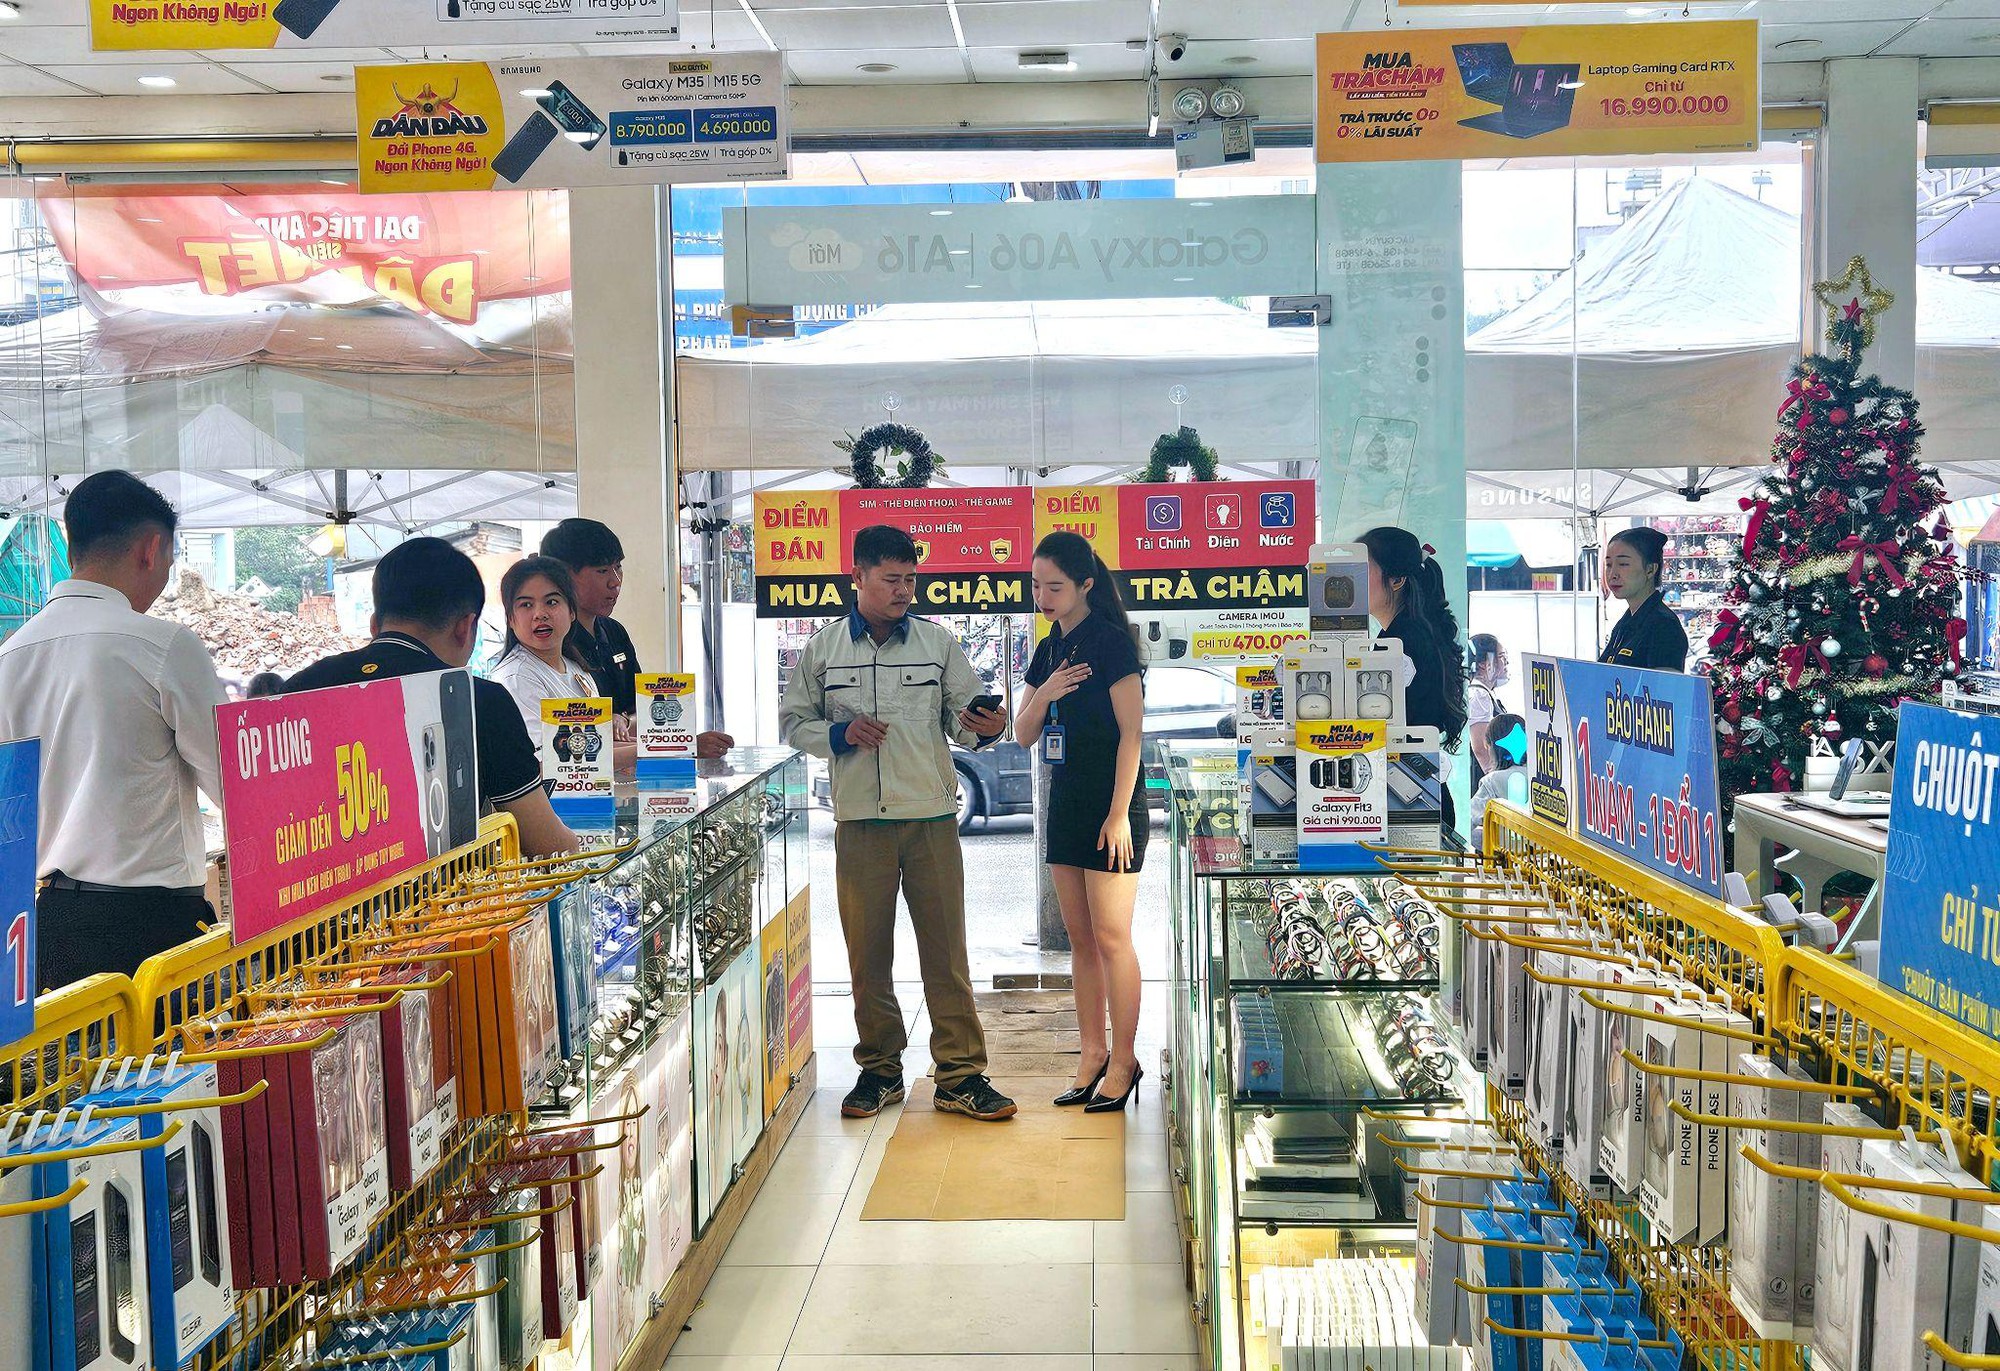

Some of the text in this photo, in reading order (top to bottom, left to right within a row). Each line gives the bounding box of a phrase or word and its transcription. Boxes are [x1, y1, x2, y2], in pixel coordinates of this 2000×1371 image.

[112, 4, 158, 24] Ngon
[162, 2, 220, 23] Không
[1362, 52, 1412, 69] MUA
[1588, 61, 1735, 76] Laptop Gaming Card RTX
[622, 73, 762, 92] Galaxy M35 M15 5G
[1600, 95, 1730, 117] 16.990.000
[616, 122, 686, 138] 8.790.000
[700, 119, 771, 134] 4.690.000
[1336, 123, 1423, 139] 0% LÃI SUẤT
[412, 142, 452, 155] Phone
[629, 151, 654, 162] Tặng
[669, 151, 688, 161] sạc
[689, 149, 710, 157] 25W
[738, 147, 757, 160] góp
[759, 147, 772, 155] 0%
[375, 159, 408, 174] Ngon
[411, 157, 452, 174] Không
[859, 499, 877, 510] SIM
[903, 497, 928, 511] ĐIỆN
[928, 498, 958, 511] THOẠI
[985, 498, 1013, 507] GAME
[1047, 489, 1101, 514] ĐIỂM
[763, 500, 829, 529] ĐIỂM
[770, 536, 824, 562] BÁN
[1136, 535, 1191, 550] Tài Chính
[1207, 535, 1239, 551] Điện
[1259, 533, 1294, 547] Nước
[769, 583, 843, 606] MUA
[926, 574, 1022, 611] CHẬM
[1130, 568, 1303, 604] TRẢ CHẬM
[1218, 612, 1285, 621] CAMERA IMOU
[1605, 680, 1674, 755] BẢO HÀNH
[649, 734, 693, 743] 790.000
[1330, 725, 1354, 734] MUA
[236, 710, 313, 780] ỐP LƯNG
[575, 765, 599, 773] Series
[335, 740, 390, 842] 50%
[1912, 731, 2000, 838] CHUỘT
[1312, 803, 1372, 815] Galaxy Fit3
[1577, 717, 1594, 832] 1
[1593, 761, 1635, 849] NĂM
[1649, 793, 1660, 860] 1
[1662, 773, 1702, 878] ĐỔI
[1704, 812, 1718, 885] 1
[1302, 815, 1321, 825] Giá
[1342, 816, 1382, 825] 990.000
[275, 811, 308, 865] GIẢM
[1941, 884, 1976, 955] CHỈ
[7, 911, 28, 1007] 1
[1681, 1124, 1692, 1166] PHONE
[1708, 1127, 1719, 1170] PHONE
[338, 1203, 360, 1226] Galaxy
